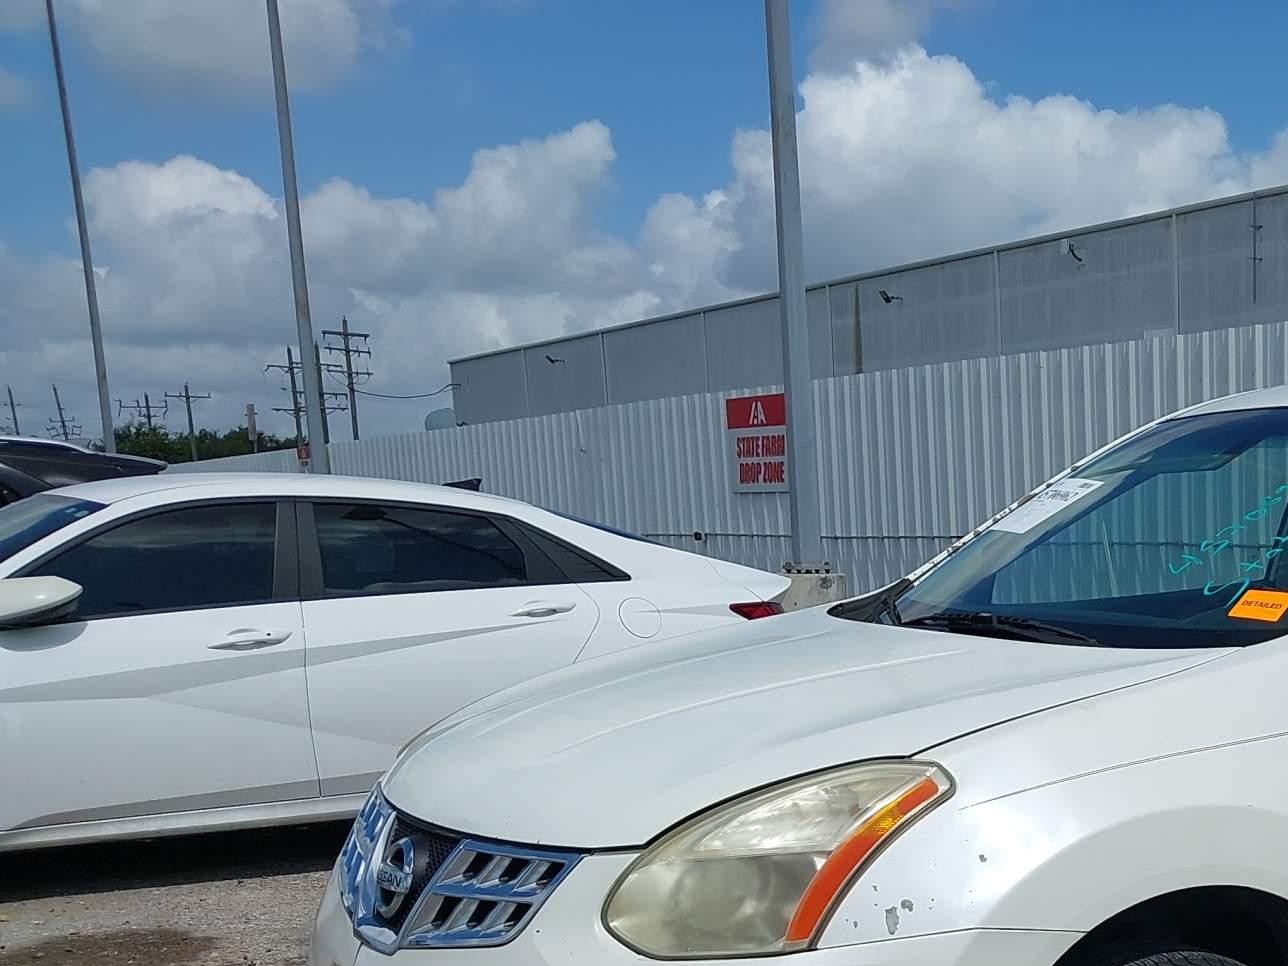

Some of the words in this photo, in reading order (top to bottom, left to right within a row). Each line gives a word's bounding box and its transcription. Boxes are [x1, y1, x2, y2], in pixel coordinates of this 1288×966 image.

[736, 435, 761, 459] STATE
[761, 434, 786, 457] FARM
[739, 461, 762, 485] DROP
[762, 460, 785, 484] ZONE
[1241, 599, 1283, 610] DETAILED
